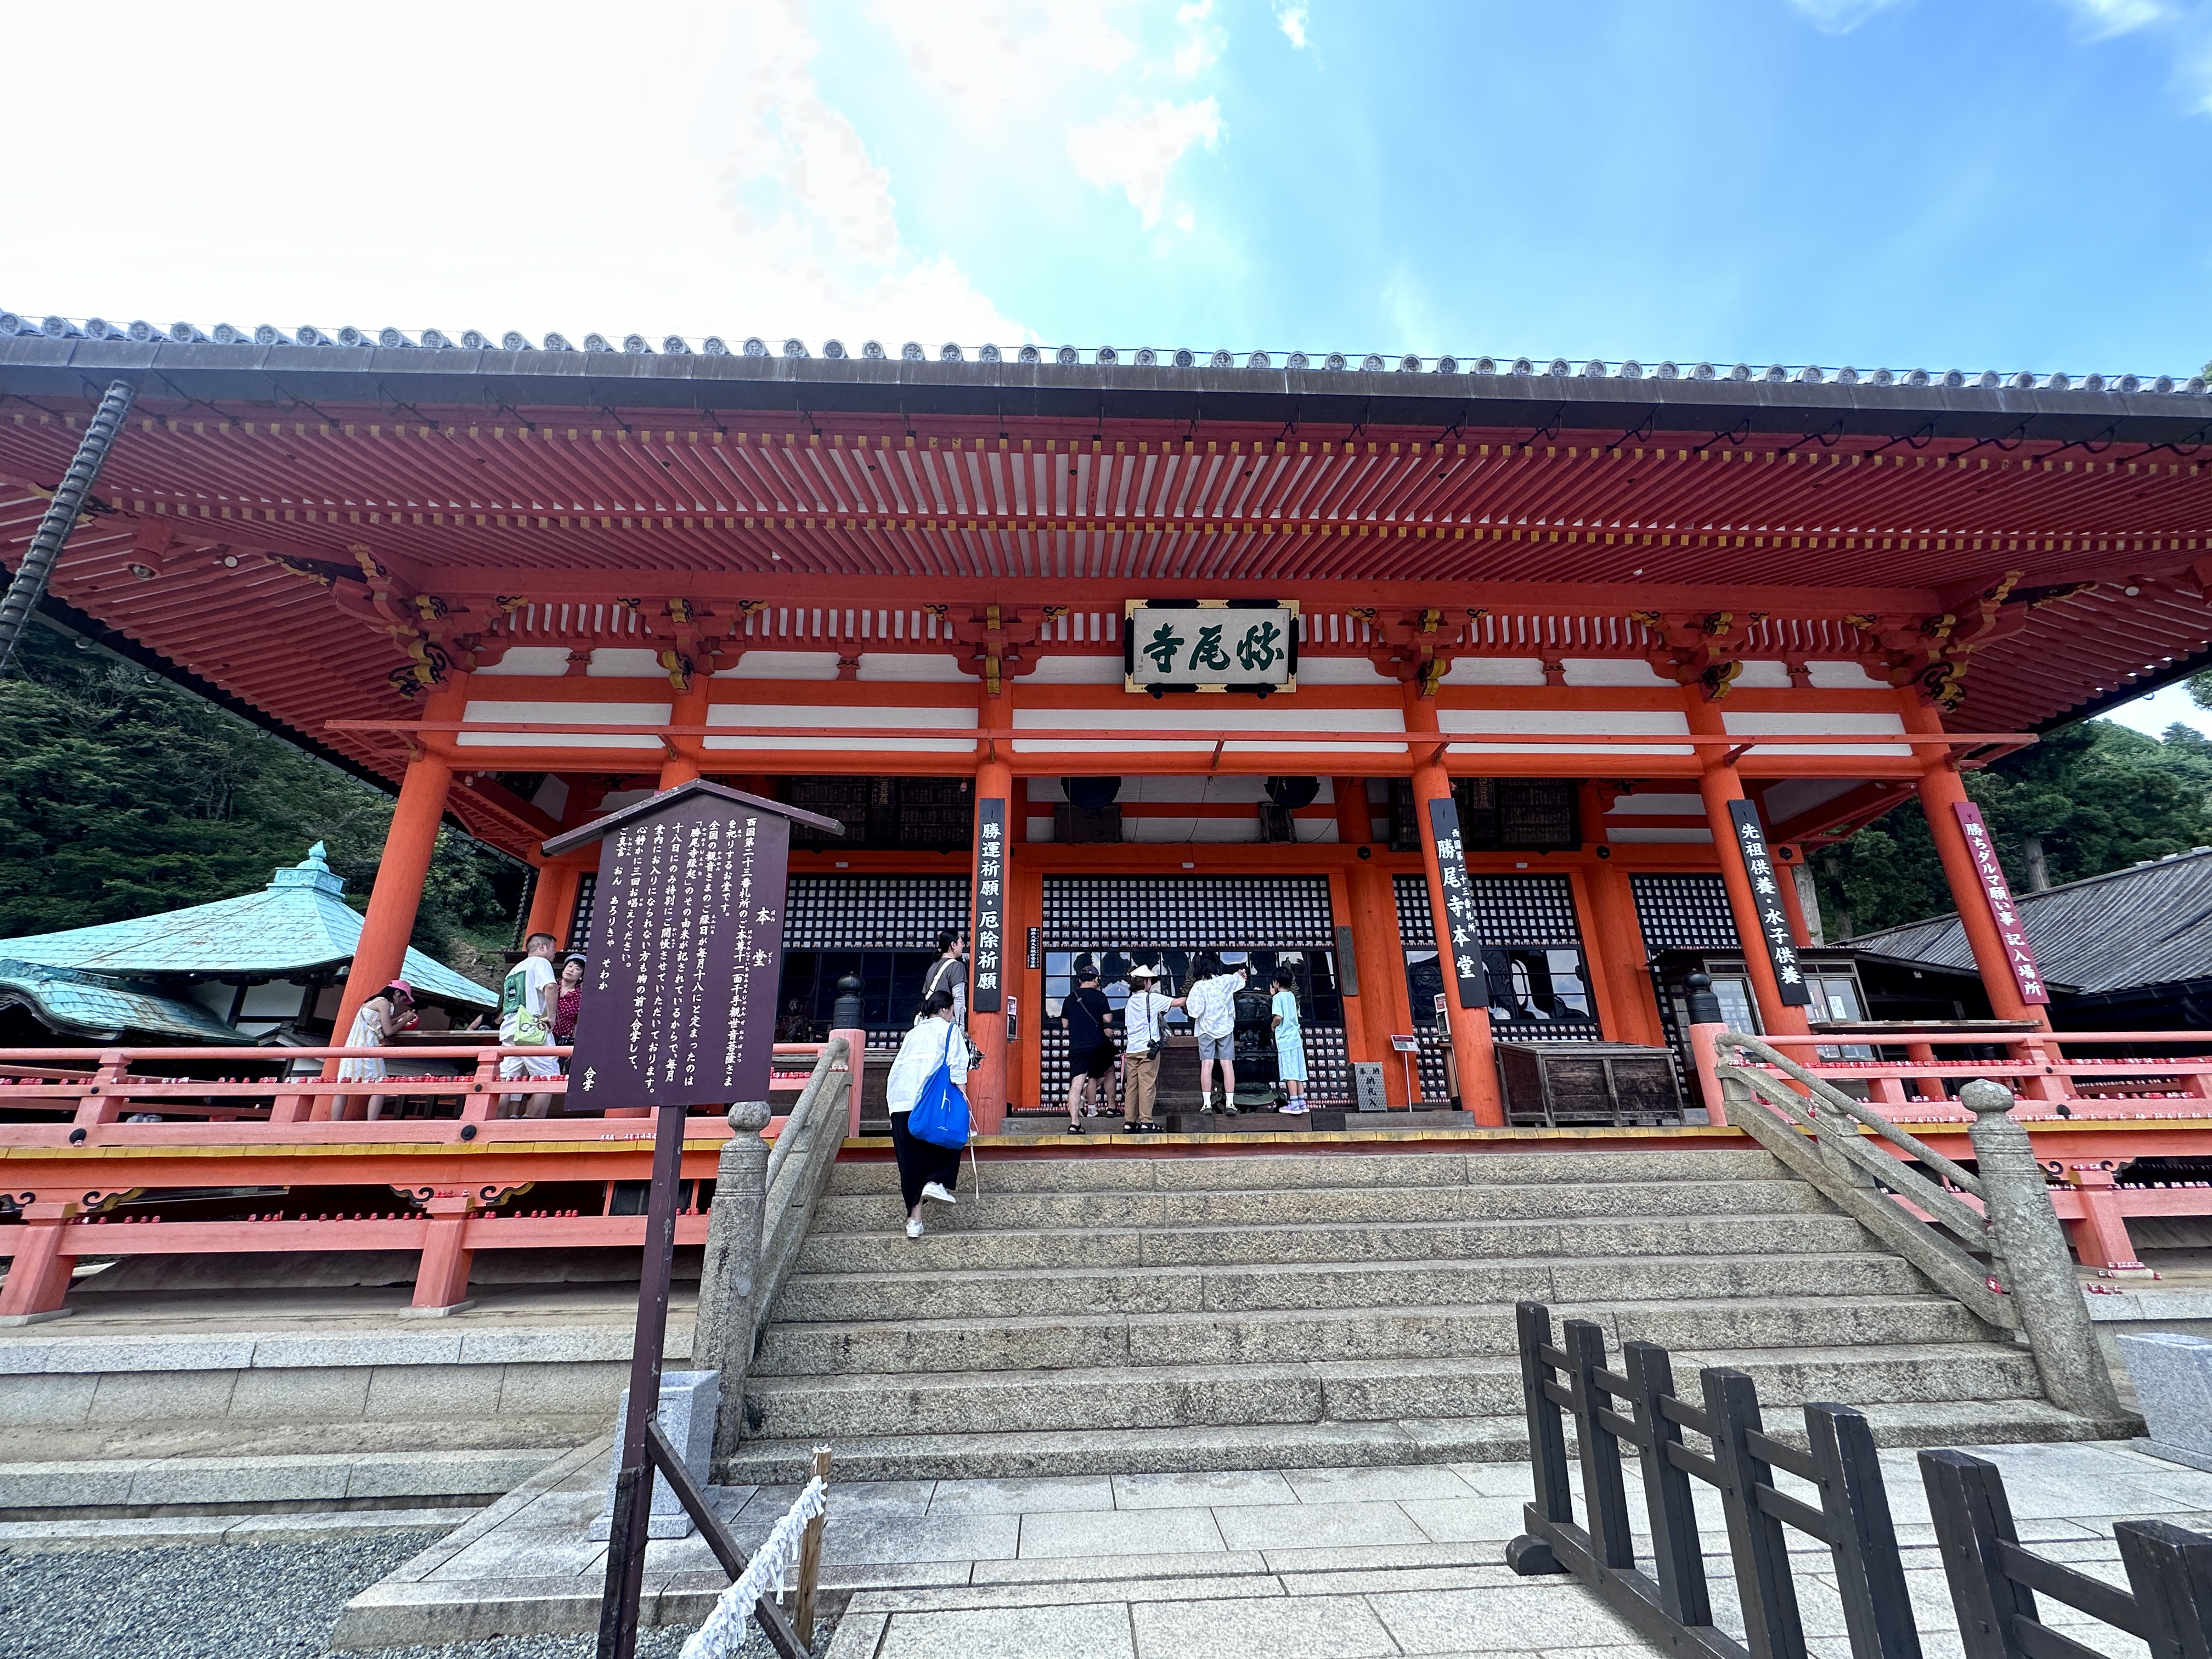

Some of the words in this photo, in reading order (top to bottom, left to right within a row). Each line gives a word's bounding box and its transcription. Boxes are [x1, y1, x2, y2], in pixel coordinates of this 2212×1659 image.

[612, 866, 624, 885] おん
[616, 827, 629, 857] ご真言
[621, 826, 648, 968] 心静かに三回お唱えください。
[720, 819, 737, 917] を祀りするお堂です。
[977, 822, 1001, 990] 勝運祈願・厄除祈願
[1437, 839, 1475, 979] 勝尾寺本堂
[1452, 828, 1476, 933] 西国第二十三番札所
[1741, 823, 1802, 984] 先祖供養・水子供養
[1965, 822, 2016, 926] 勝ちダルマ願い事
[2005, 932, 2041, 996] 記入場所
[599, 958, 611, 990] そわか
[606, 895, 619, 947] あろりきや
[628, 823, 666, 1070] 堂内にお入りになられない方も胸の前で合掌して、
[645, 822, 684, 1094] 十八日にのみ特別にご開帳させていただいております。
[684, 820, 721, 1086] 全国の観音さまのご縁日が毎月十八にと定まったのは
[724, 817, 758, 1086] 西国第二十三番札所のご本尊十一面千手観世音菩薩さま
[583, 1066, 596, 1092] 合掌
